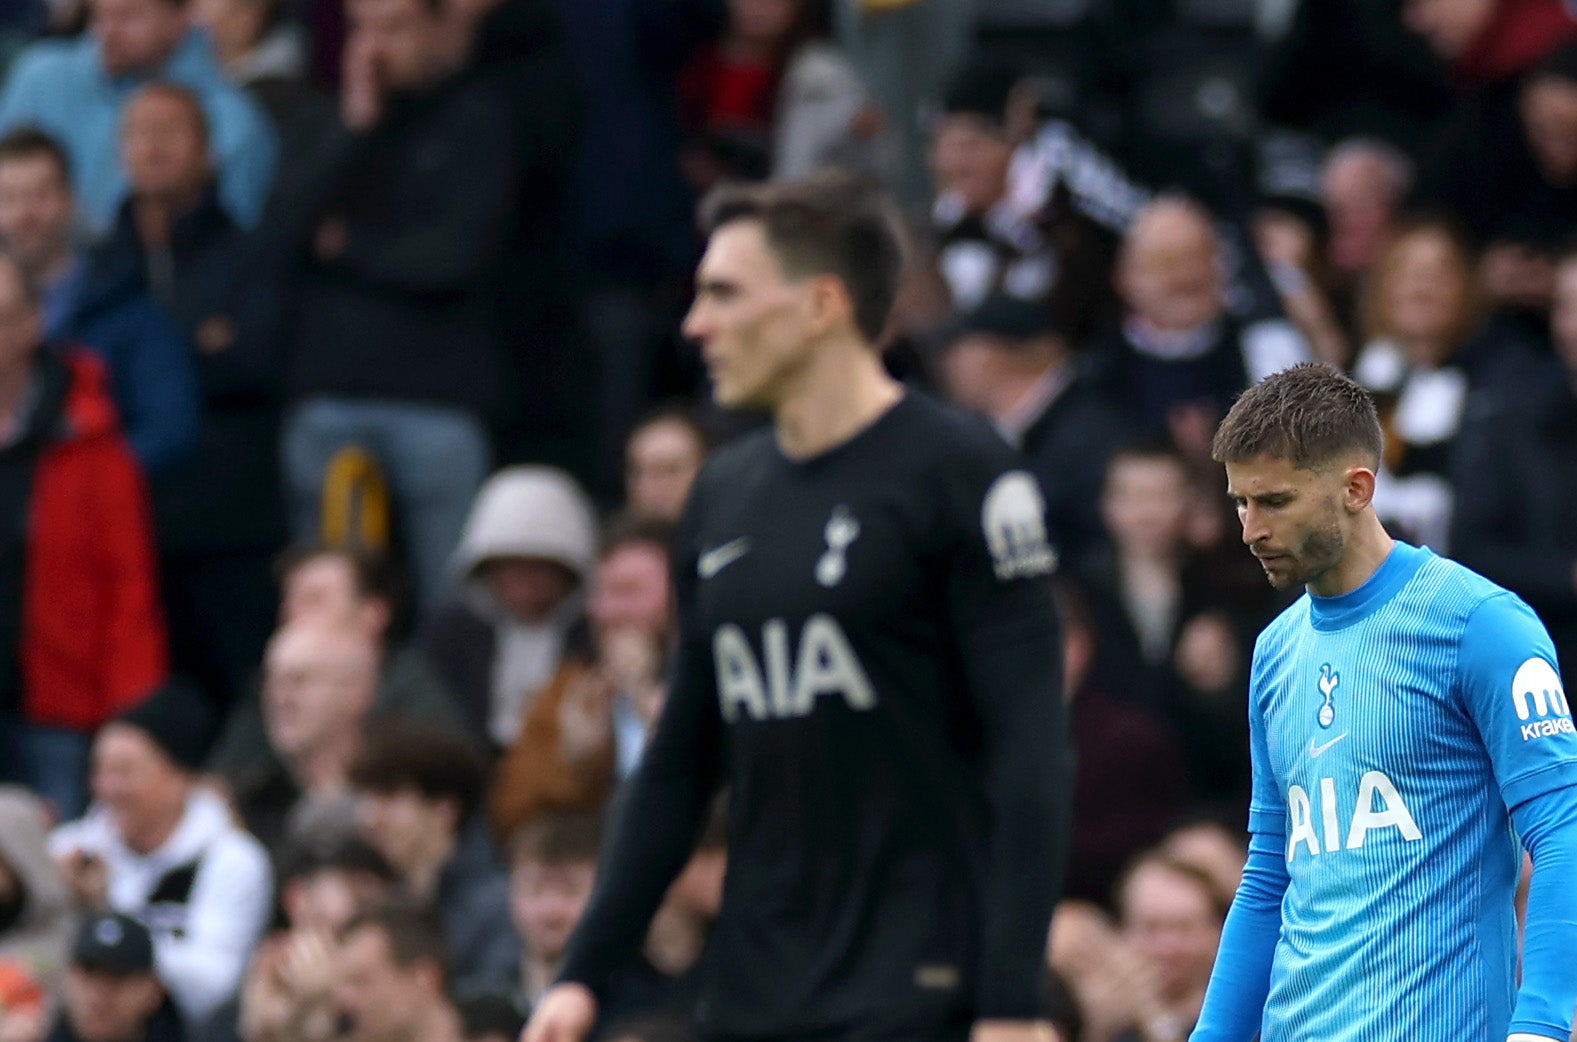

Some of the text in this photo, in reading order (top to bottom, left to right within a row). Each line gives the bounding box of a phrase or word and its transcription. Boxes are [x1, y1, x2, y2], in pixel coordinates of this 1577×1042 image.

[713, 613, 877, 723] AIA
[1520, 717, 1576, 741] krake
[1287, 770, 1424, 863] AIA
